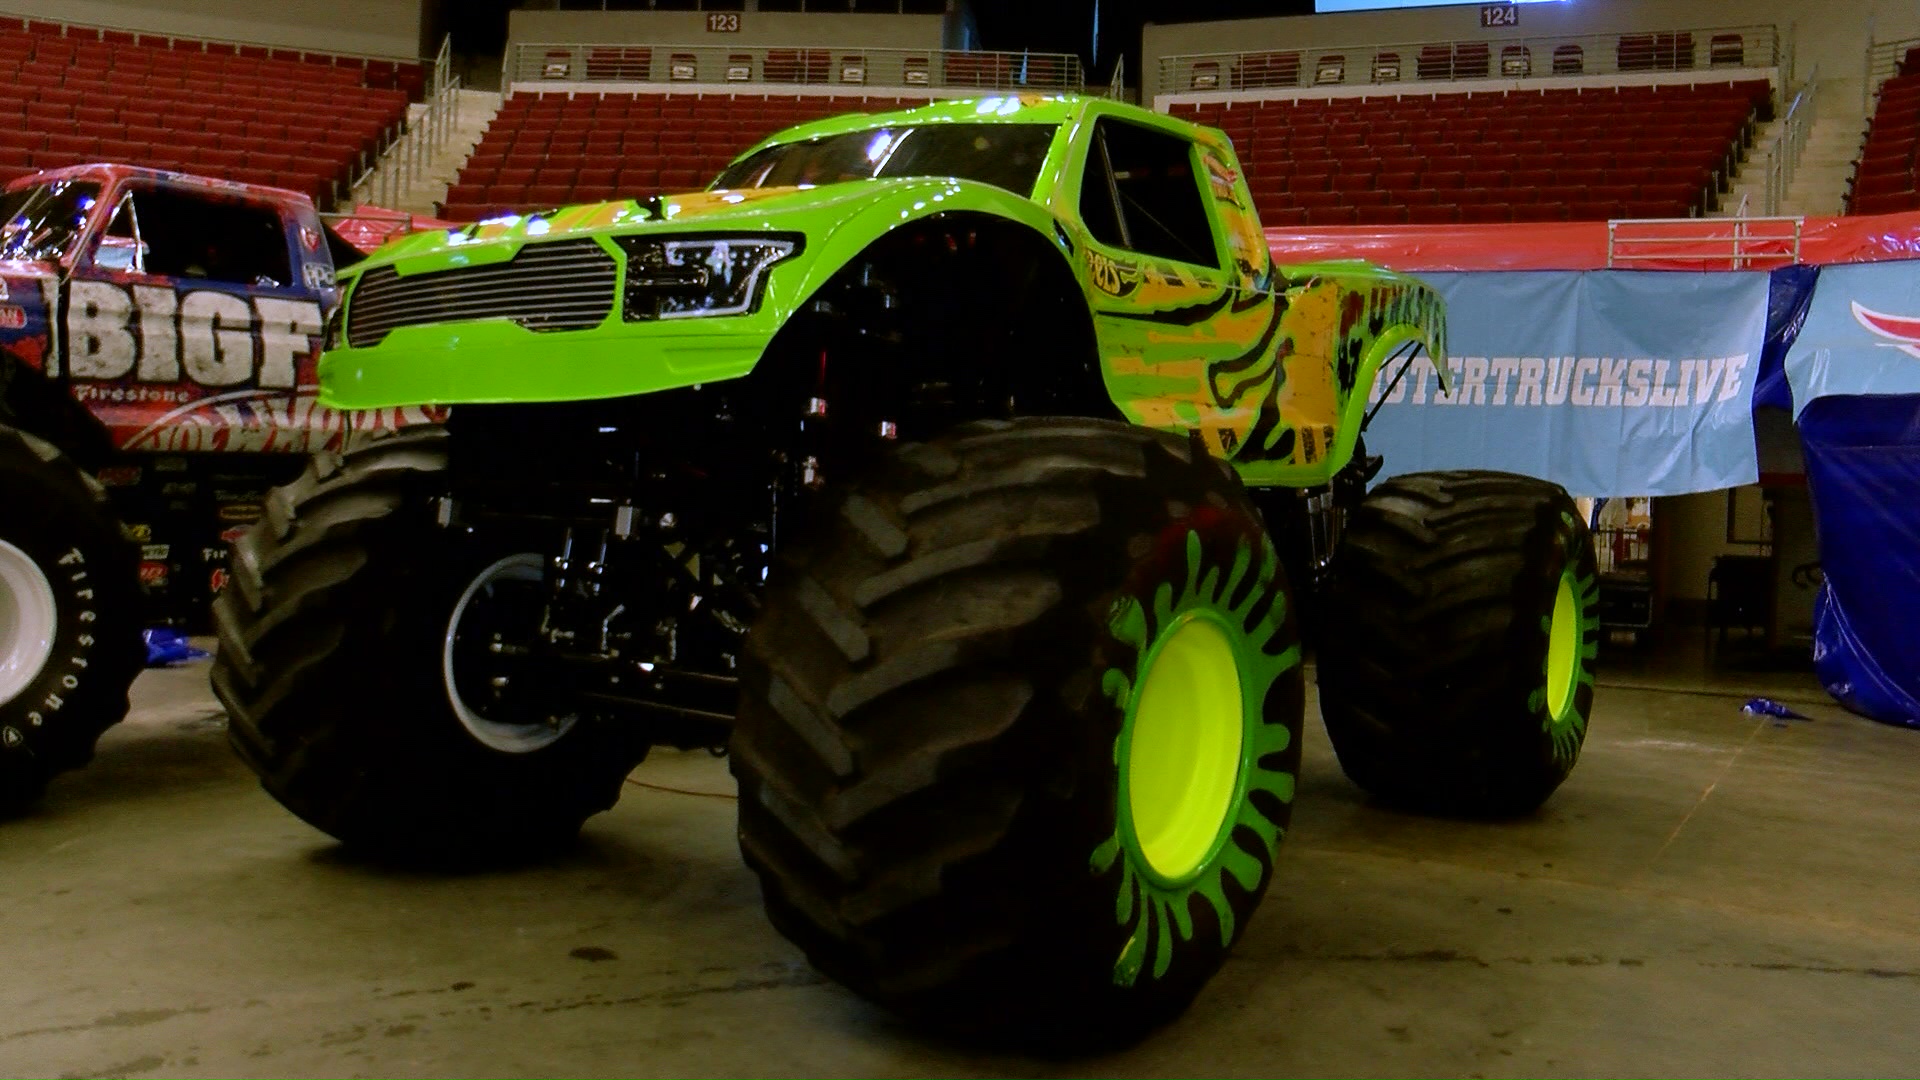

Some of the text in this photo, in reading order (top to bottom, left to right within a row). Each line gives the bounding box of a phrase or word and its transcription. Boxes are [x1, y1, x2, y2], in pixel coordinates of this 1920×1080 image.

[710, 15, 738, 31] 123
[1484, 7, 1515, 25] 124
[75, 384, 190, 402] Firestone
[28, 548, 96, 727] Firestone
